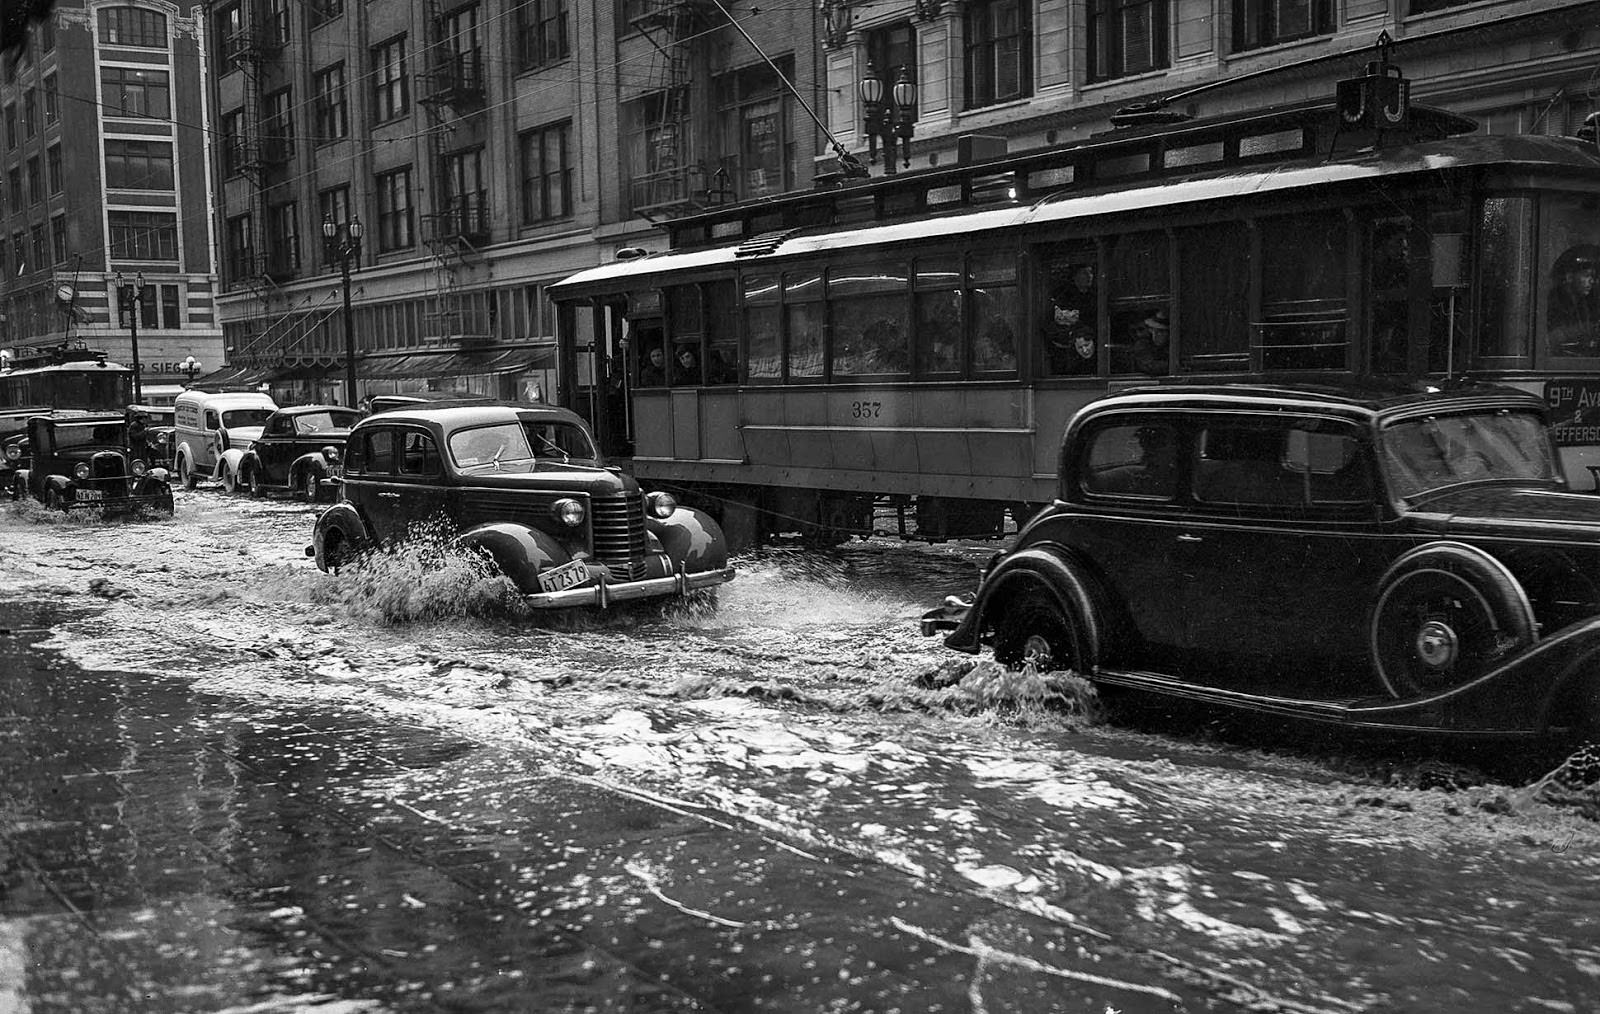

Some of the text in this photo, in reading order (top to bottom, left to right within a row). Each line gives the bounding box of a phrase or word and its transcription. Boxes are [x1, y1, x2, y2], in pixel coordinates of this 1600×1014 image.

[1343, 82, 1366, 122] J
[1383, 83, 1405, 123] J
[1549, 386, 1574, 408] 9TH
[852, 400, 881, 418] 357
[1574, 409, 1582, 423] &
[1554, 426, 1600, 442] EFFERS
[558, 571, 574, 587] 23
[572, 566, 586, 582] 79
